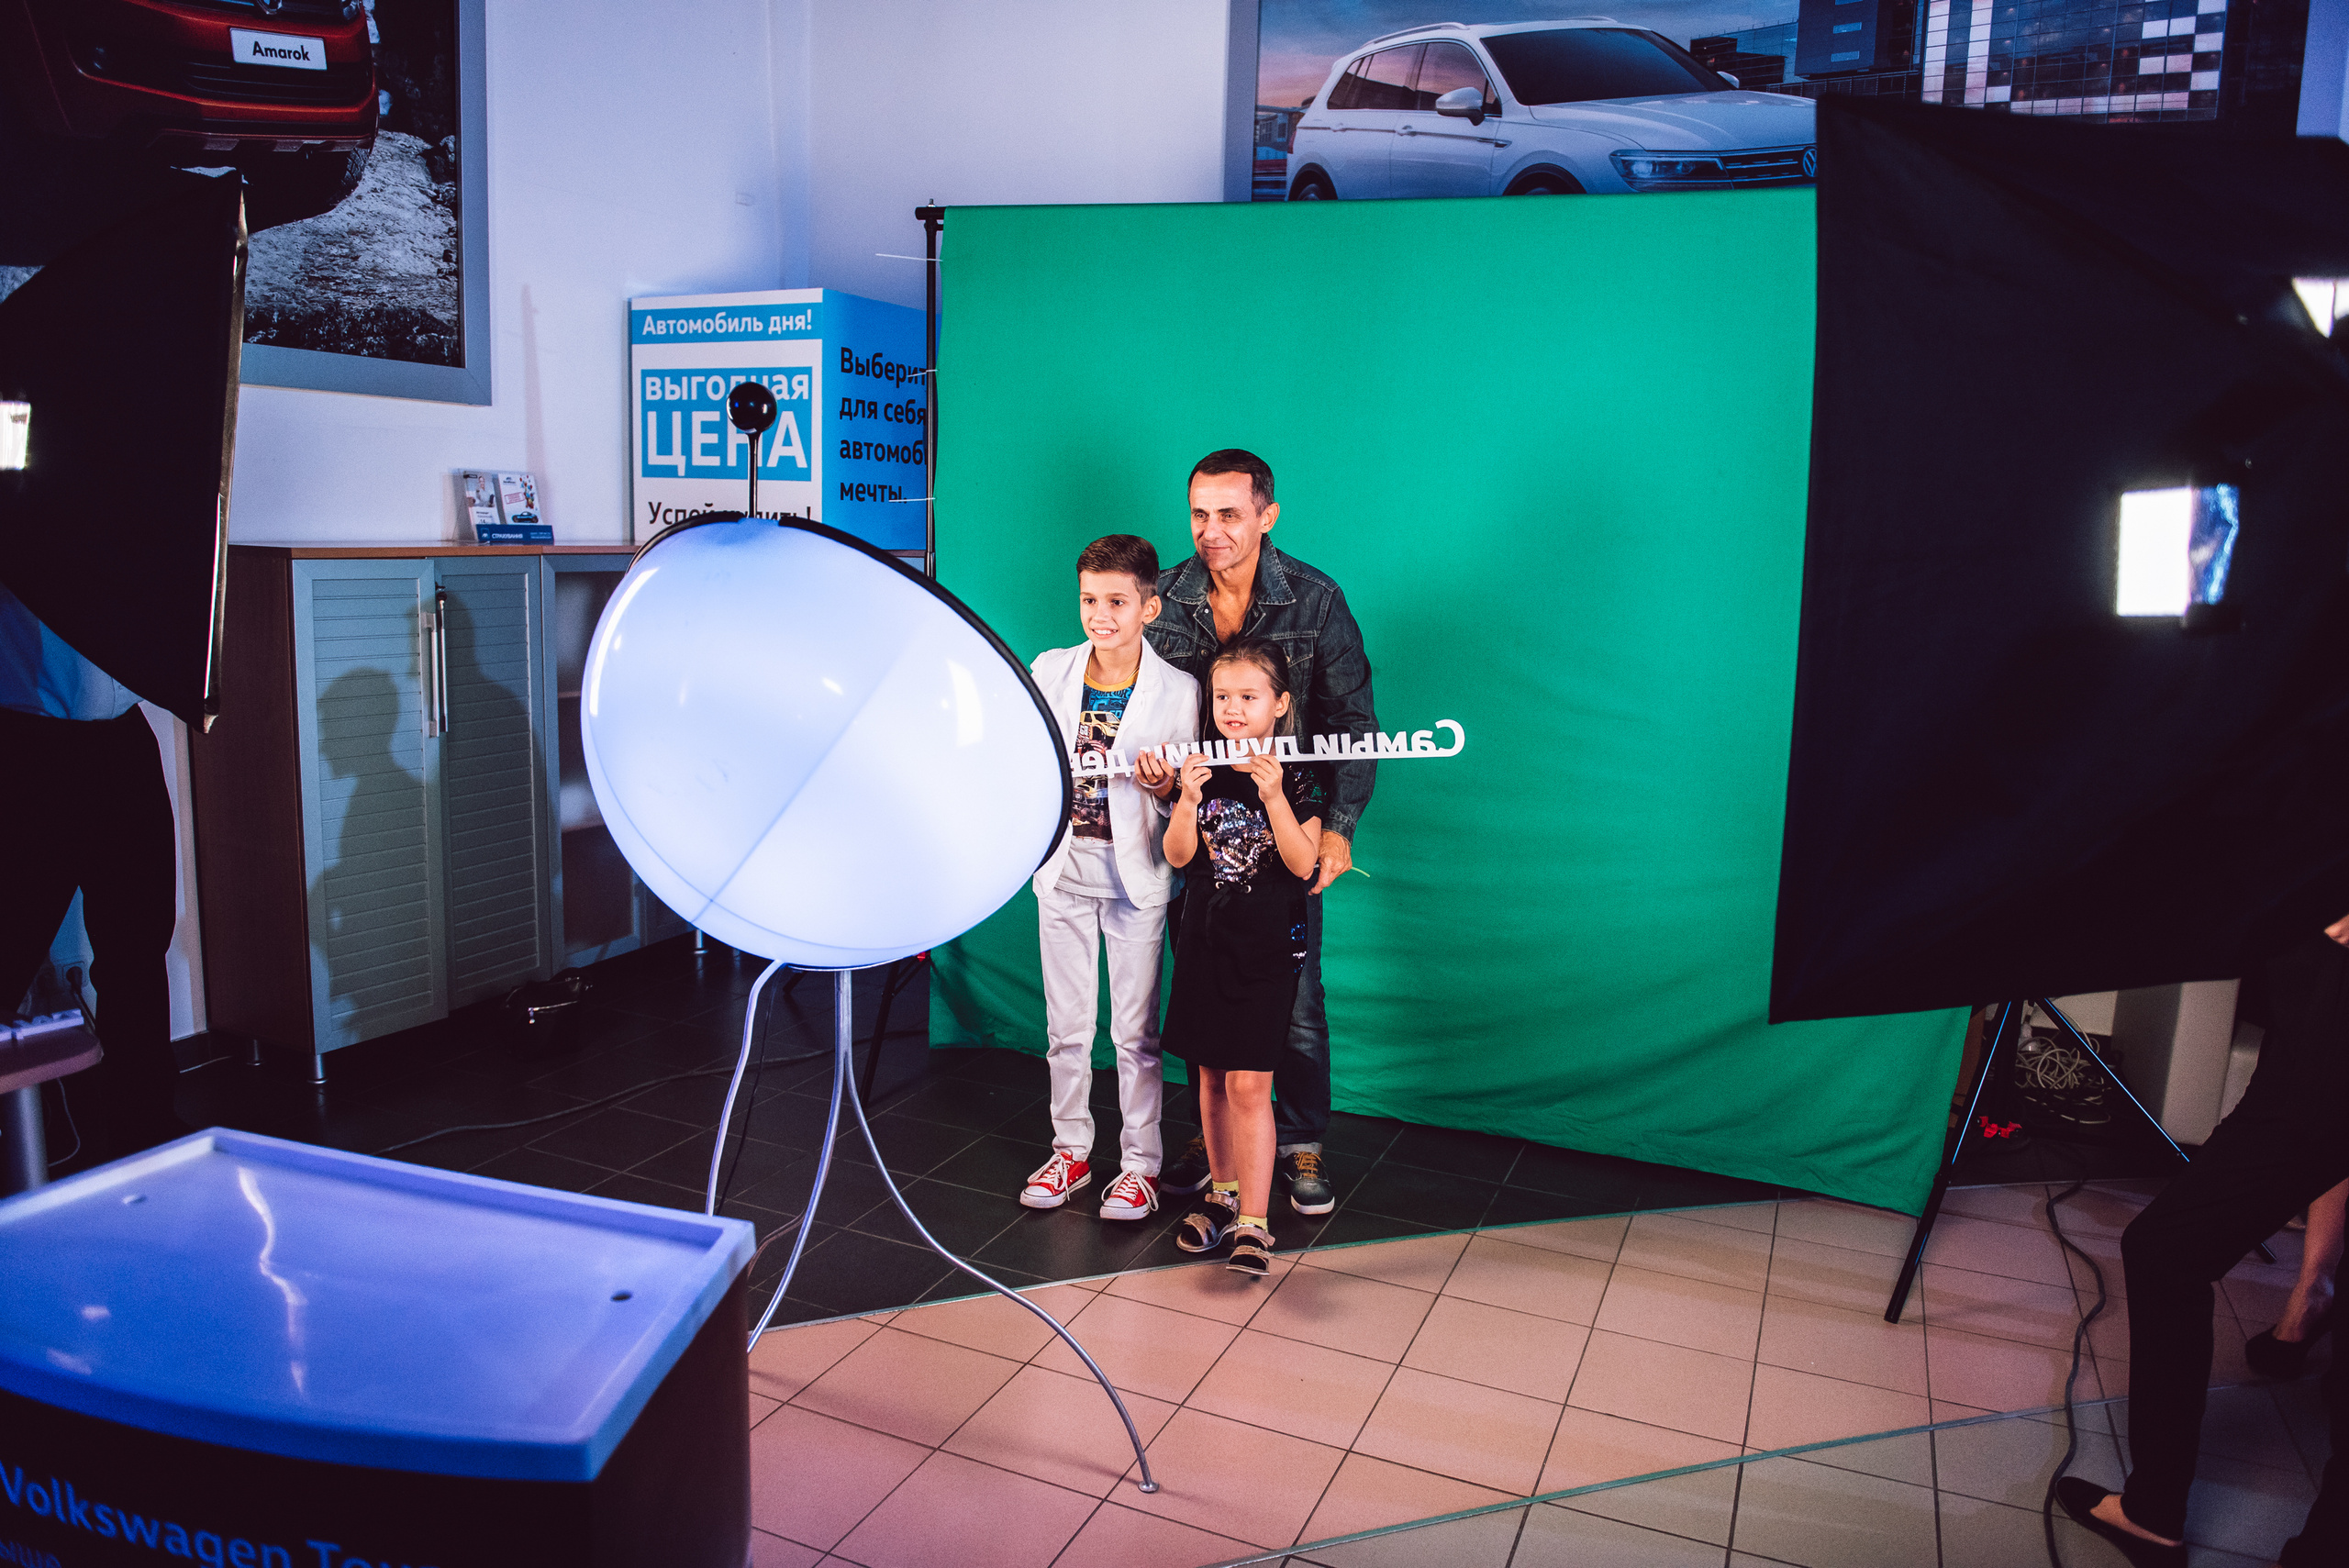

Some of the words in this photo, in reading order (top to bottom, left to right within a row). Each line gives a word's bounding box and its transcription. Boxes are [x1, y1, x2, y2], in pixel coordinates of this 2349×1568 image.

[252, 40, 310, 61] Amarok
[642, 311, 763, 336] Автомобиль
[768, 308, 812, 335] дня!
[840, 397, 878, 421] для
[884, 399, 927, 425] себя
[840, 439, 927, 466] автомоб
[840, 483, 907, 504] мечты.
[0, 1460, 291, 1568] Volkswagen
